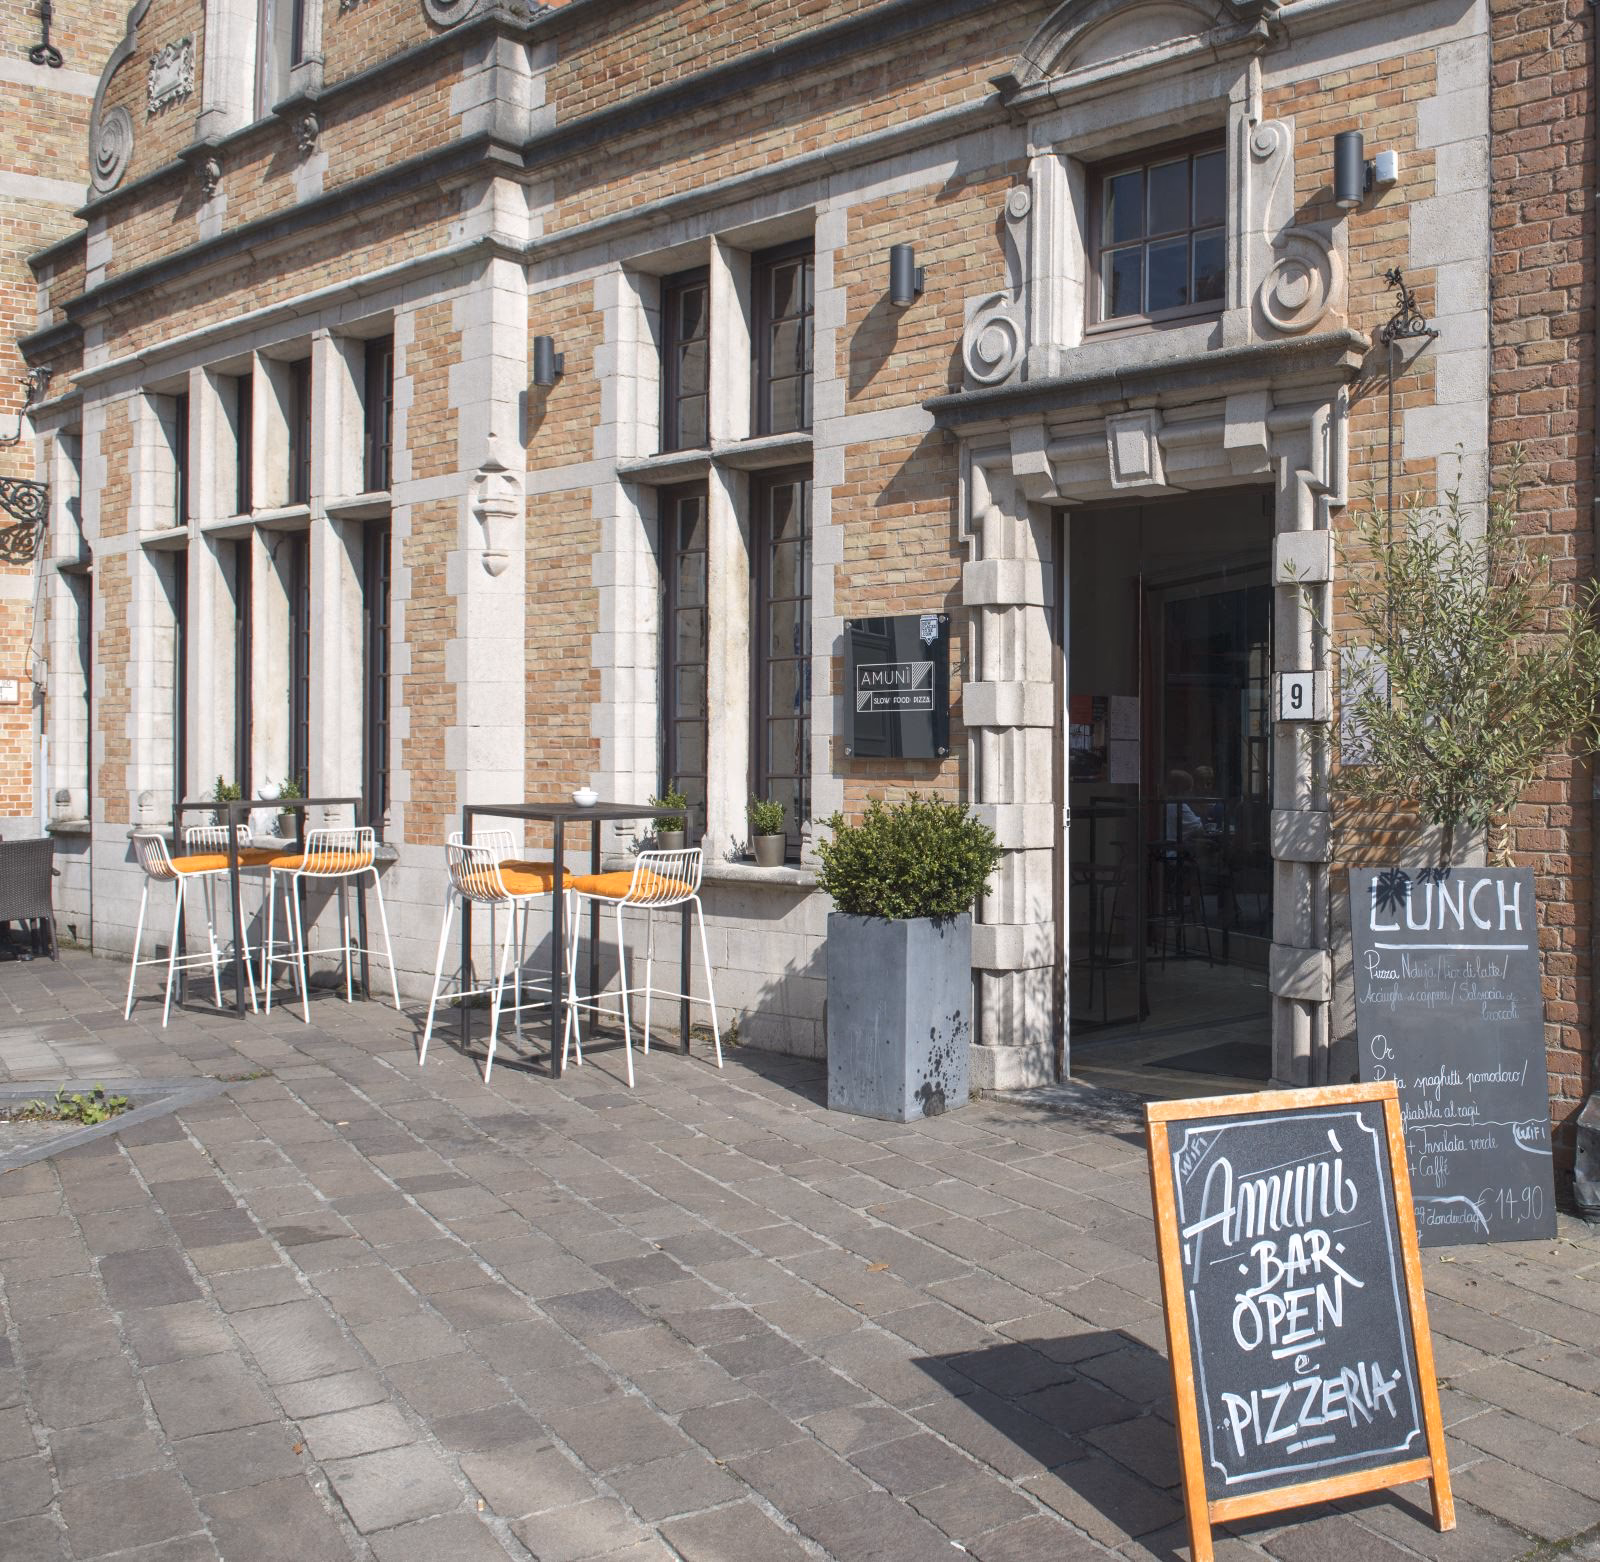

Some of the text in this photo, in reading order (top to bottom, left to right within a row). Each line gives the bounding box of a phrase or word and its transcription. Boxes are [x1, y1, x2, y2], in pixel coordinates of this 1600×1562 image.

[913, 695, 931, 703] PIZZA
[1291, 683, 1303, 710] 9
[1369, 876, 1523, 931] LUNCH
[1363, 949, 1400, 980] Pizza
[1370, 1034, 1395, 1061] Or
[1373, 1064, 1407, 1089] Pta
[1413, 1064, 1463, 1102] spaghetti
[1443, 1100, 1457, 1120] al
[1415, 1127, 1468, 1155] Insalata
[1232, 1275, 1344, 1351] OPEN
[1221, 1362, 1398, 1457] PIZZERIA
